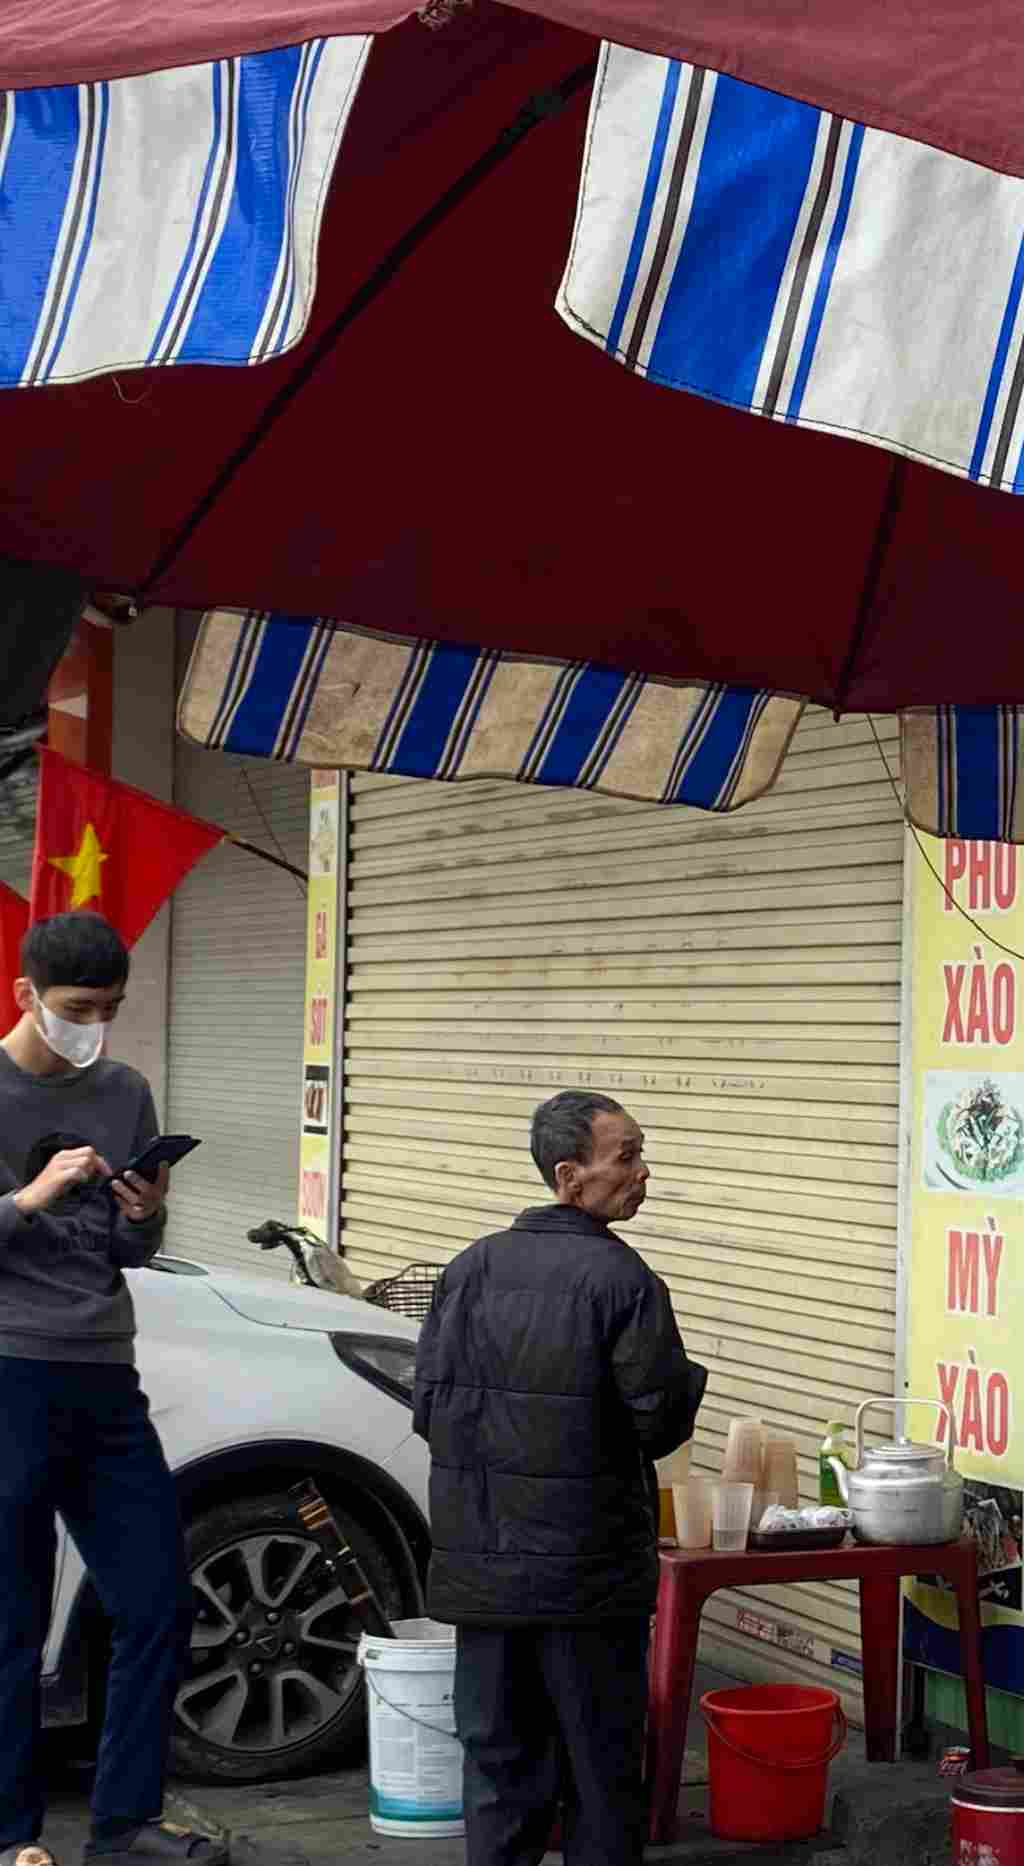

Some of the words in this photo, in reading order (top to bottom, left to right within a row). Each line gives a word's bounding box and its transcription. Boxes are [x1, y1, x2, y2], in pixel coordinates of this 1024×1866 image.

[942, 945, 1015, 1044] XÀO
[947, 1216, 1003, 1316] MỲ
[935, 1350, 1010, 1457] XÀO
